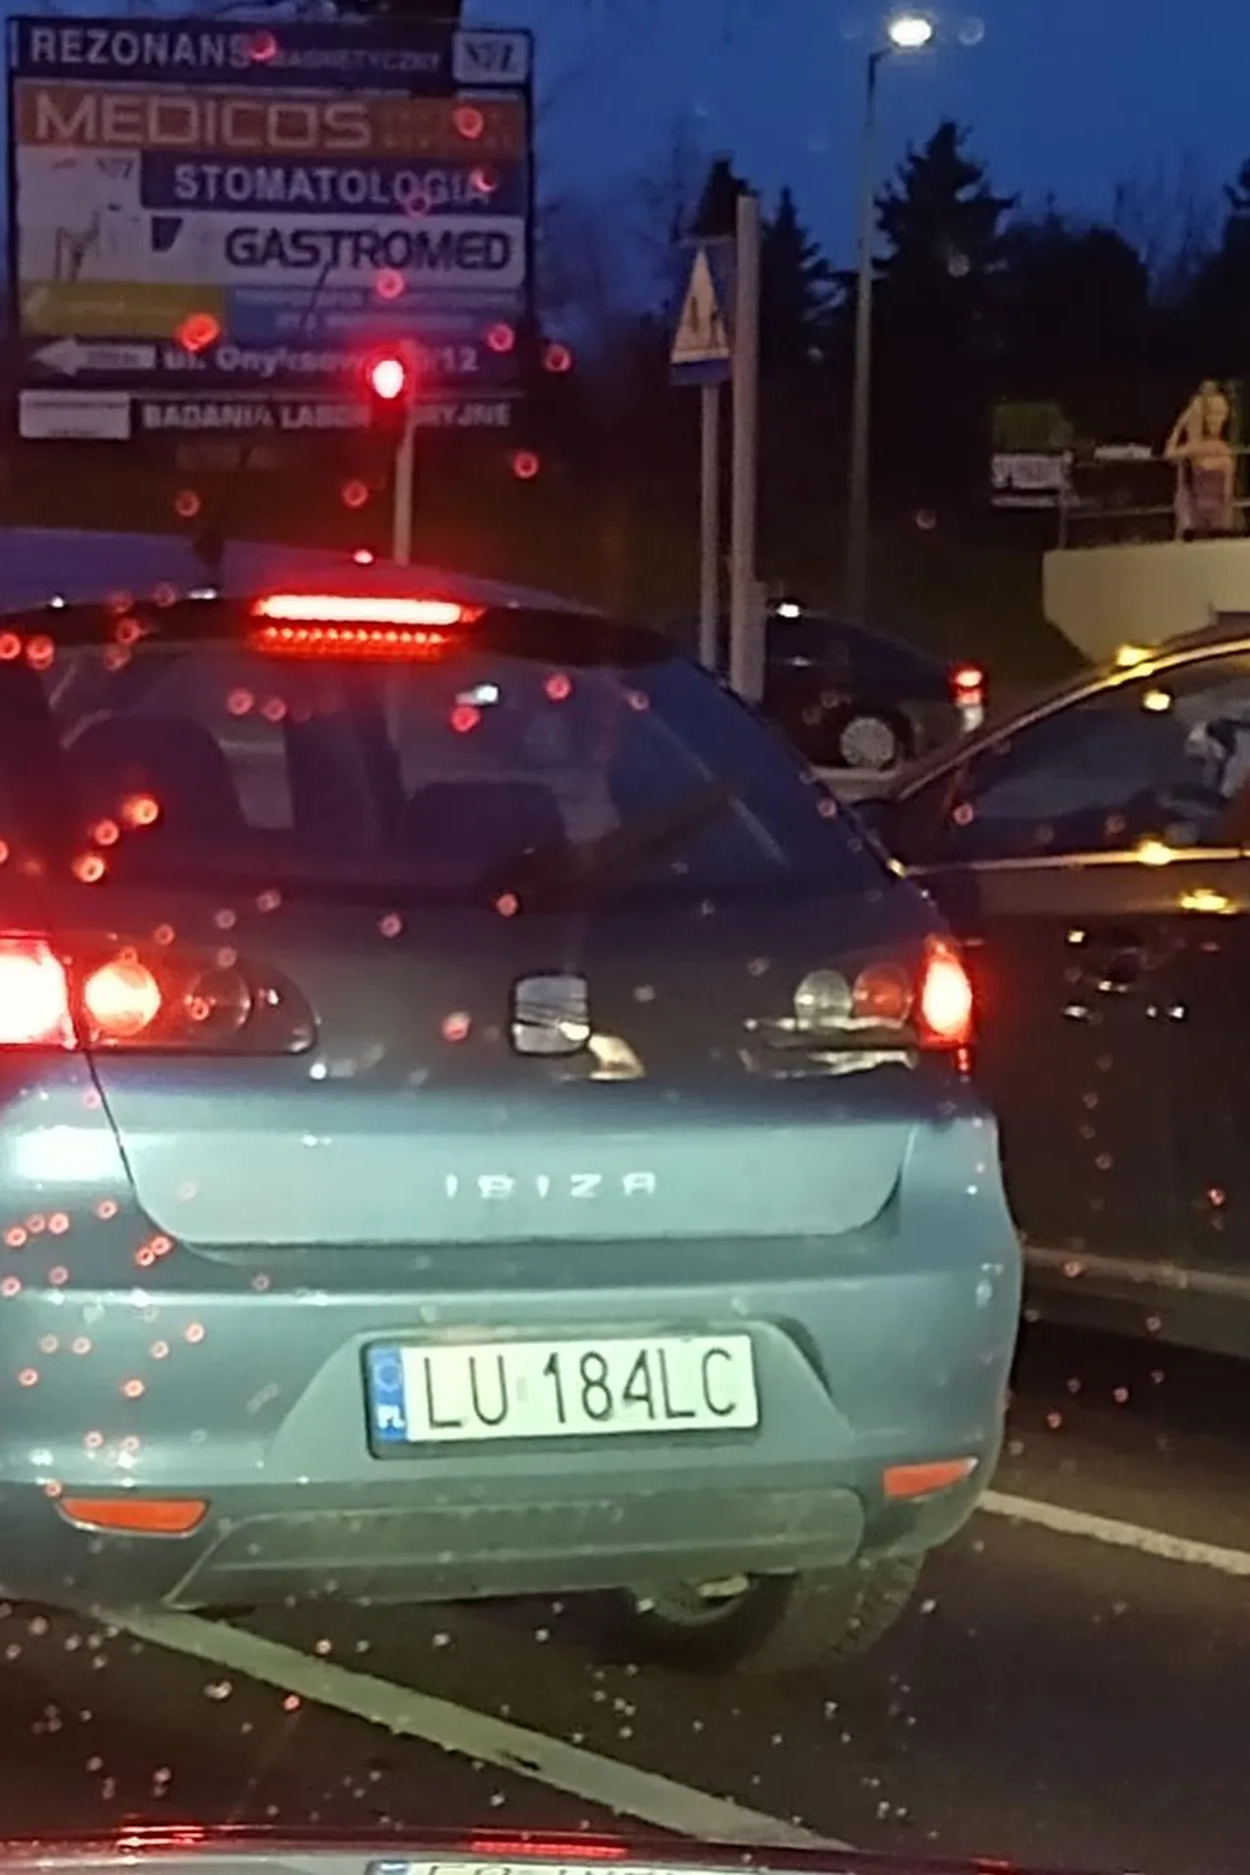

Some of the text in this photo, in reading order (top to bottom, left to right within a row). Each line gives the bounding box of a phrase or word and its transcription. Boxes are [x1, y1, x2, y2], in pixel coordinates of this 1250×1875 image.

[30, 27, 254, 68] REZONANS
[35, 91, 372, 149] MEDICOS
[175, 168, 491, 205] STOMATOLOGIA
[224, 228, 512, 270] GASTROMED
[142, 404, 276, 429] BADANIA
[445, 1172, 657, 1200] IBIZA
[423, 1345, 738, 1430] LU 184LC
